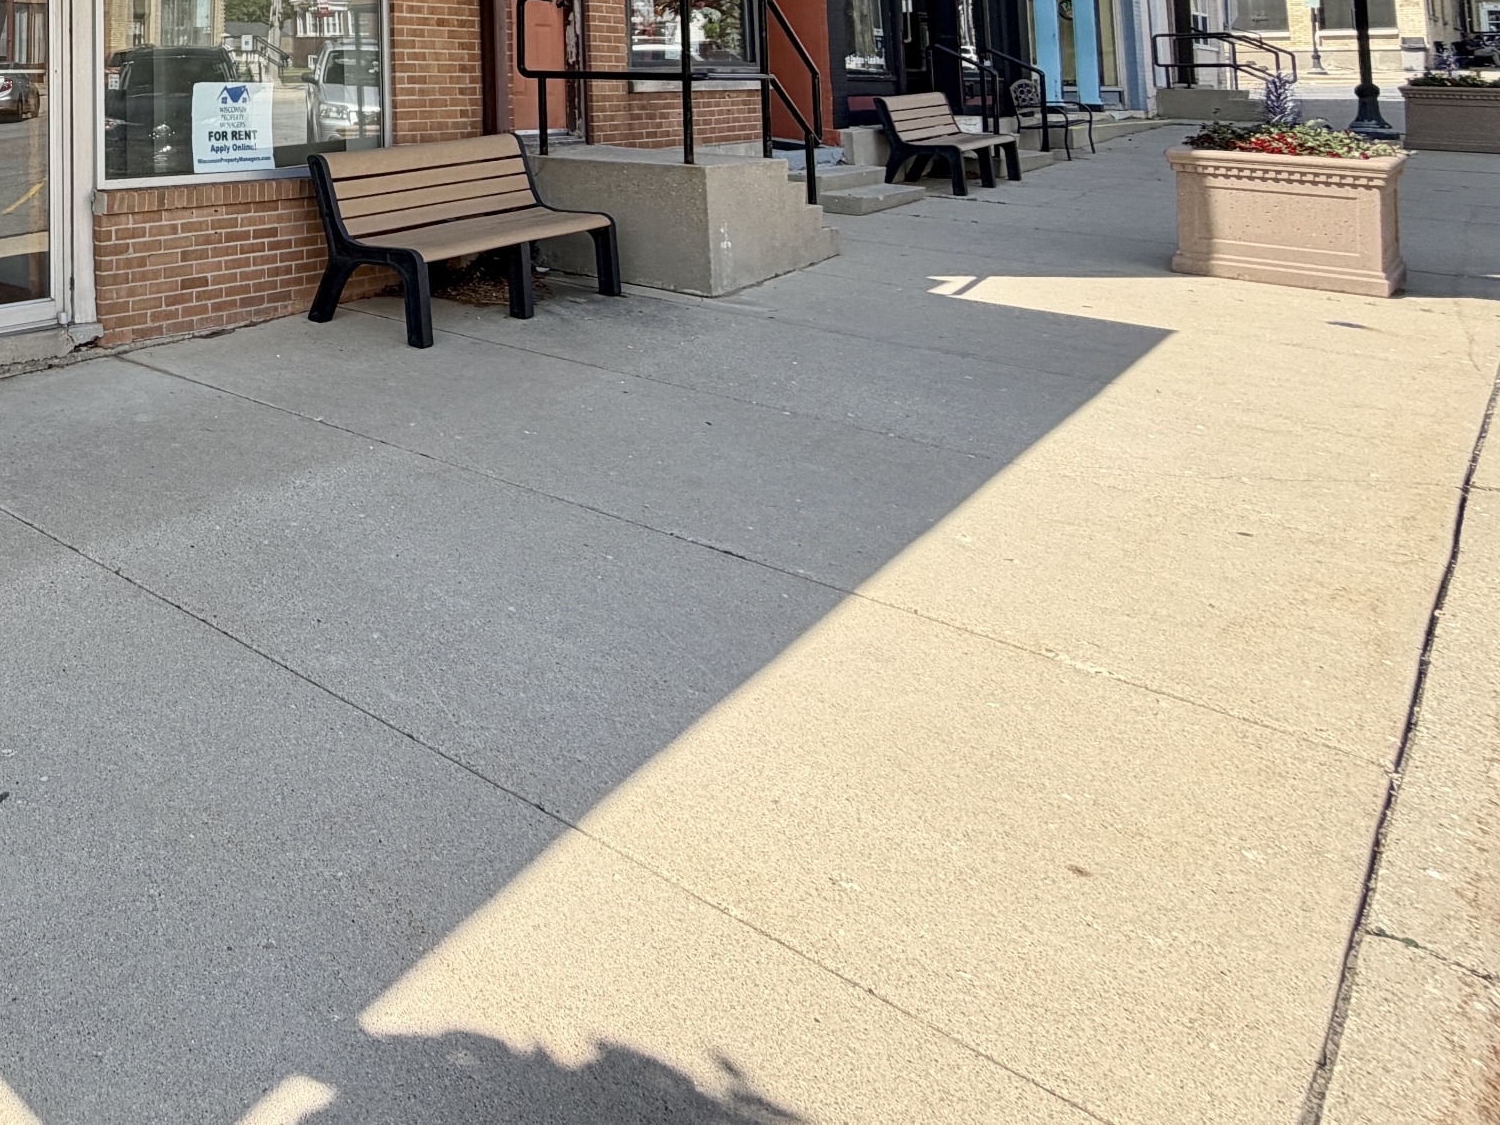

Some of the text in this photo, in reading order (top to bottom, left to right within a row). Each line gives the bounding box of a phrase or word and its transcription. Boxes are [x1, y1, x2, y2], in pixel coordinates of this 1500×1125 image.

[219, 105, 247, 114] WISCONSIN
[220, 113, 244, 121] PROPERTY
[208, 130, 258, 142] FOR RENT
[210, 143, 257, 154] Apply Online!
